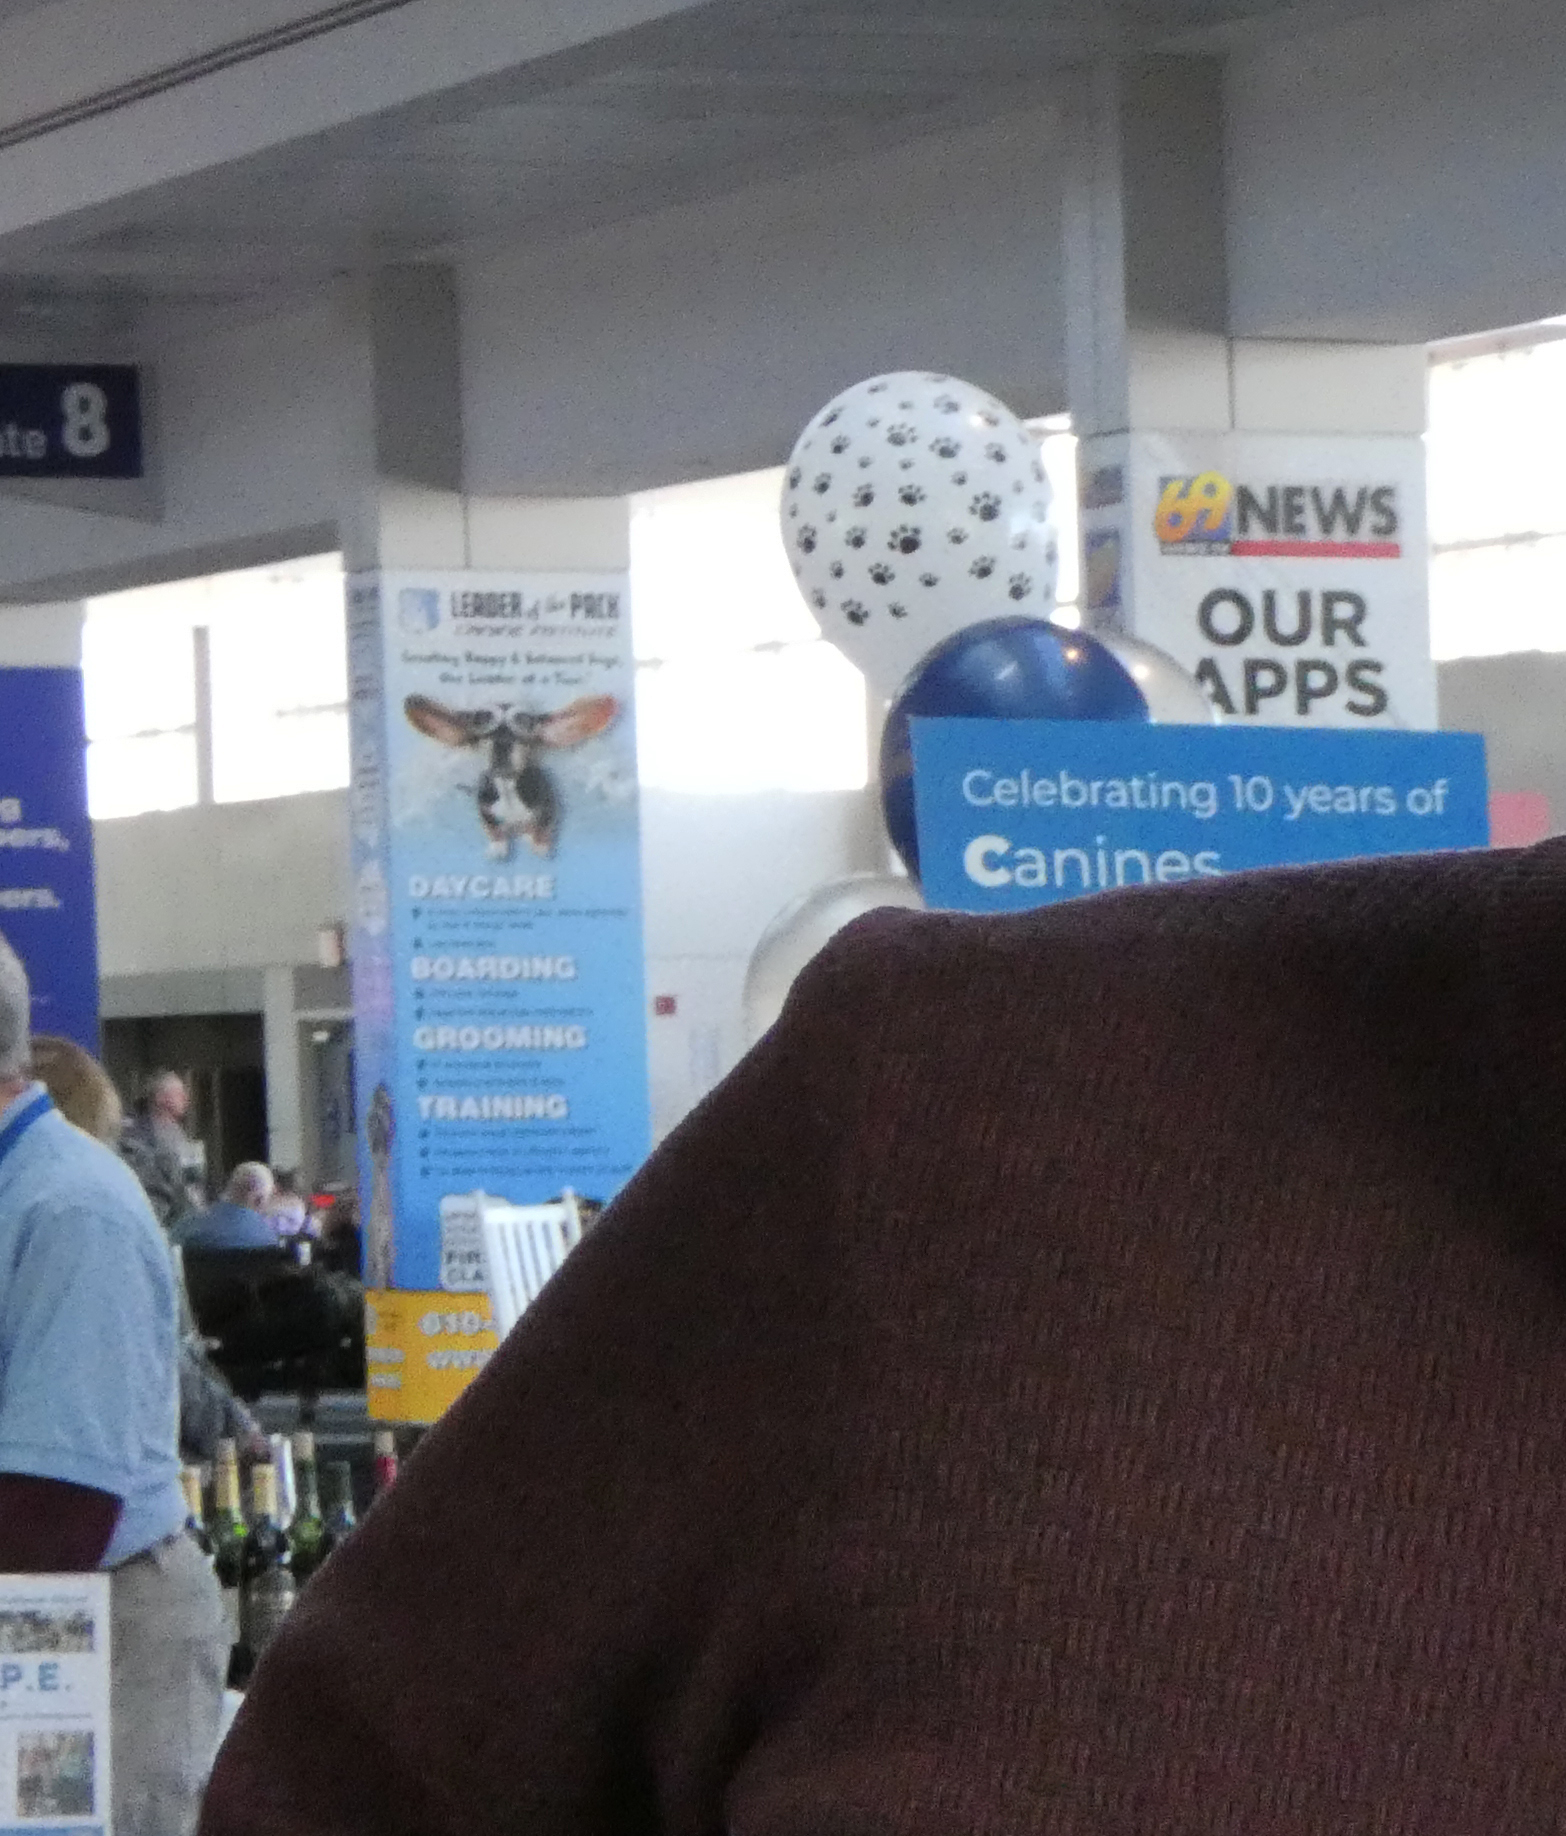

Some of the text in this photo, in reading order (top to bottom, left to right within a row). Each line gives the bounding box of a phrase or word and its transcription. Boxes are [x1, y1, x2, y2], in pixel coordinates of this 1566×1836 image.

[61, 381, 110, 457] 8
[1155, 471, 1398, 543] 69 NEWS
[1198, 587, 1367, 647] OUR
[1196, 657, 1390, 718] APPS
[961, 767, 1450, 821] Celebrating 10 years of
[408, 874, 557, 899] DAYCARE
[963, 834, 1223, 888] Canines
[411, 956, 576, 981] BOARDING
[413, 1024, 588, 1050] GROOMING
[417, 1095, 568, 1120] TRAINING
